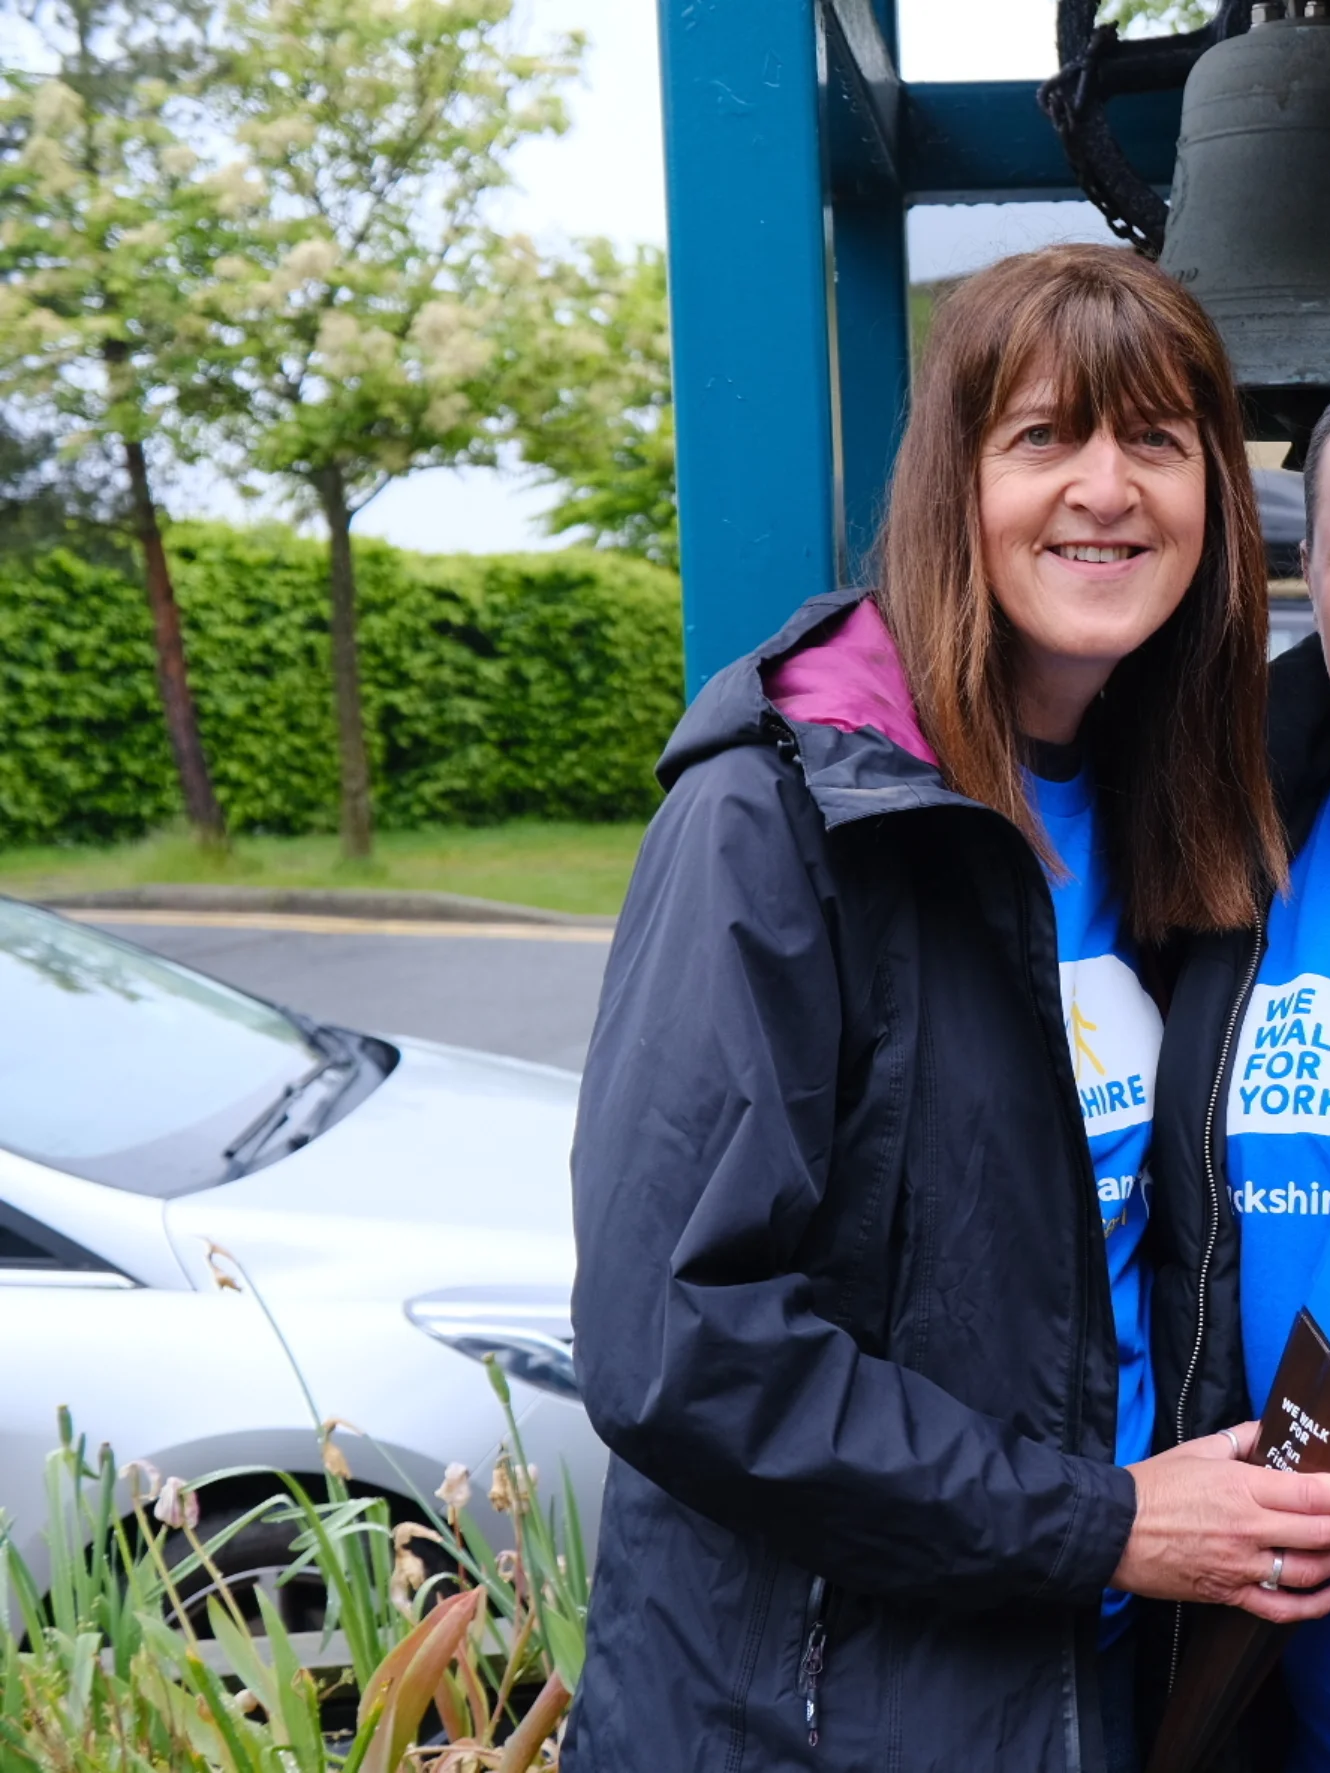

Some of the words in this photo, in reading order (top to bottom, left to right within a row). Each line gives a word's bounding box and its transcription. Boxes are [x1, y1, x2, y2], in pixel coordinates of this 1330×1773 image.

[1266, 988, 1316, 1022] WE
[1243, 1051, 1321, 1080] FOR
[1282, 1396, 1300, 1418] WE
[1300, 1412, 1330, 1444] WALK
[1289, 1421, 1310, 1446] FOR
[1266, 1446, 1296, 1472] Fitn
[1281, 1440, 1300, 1464] Fun
